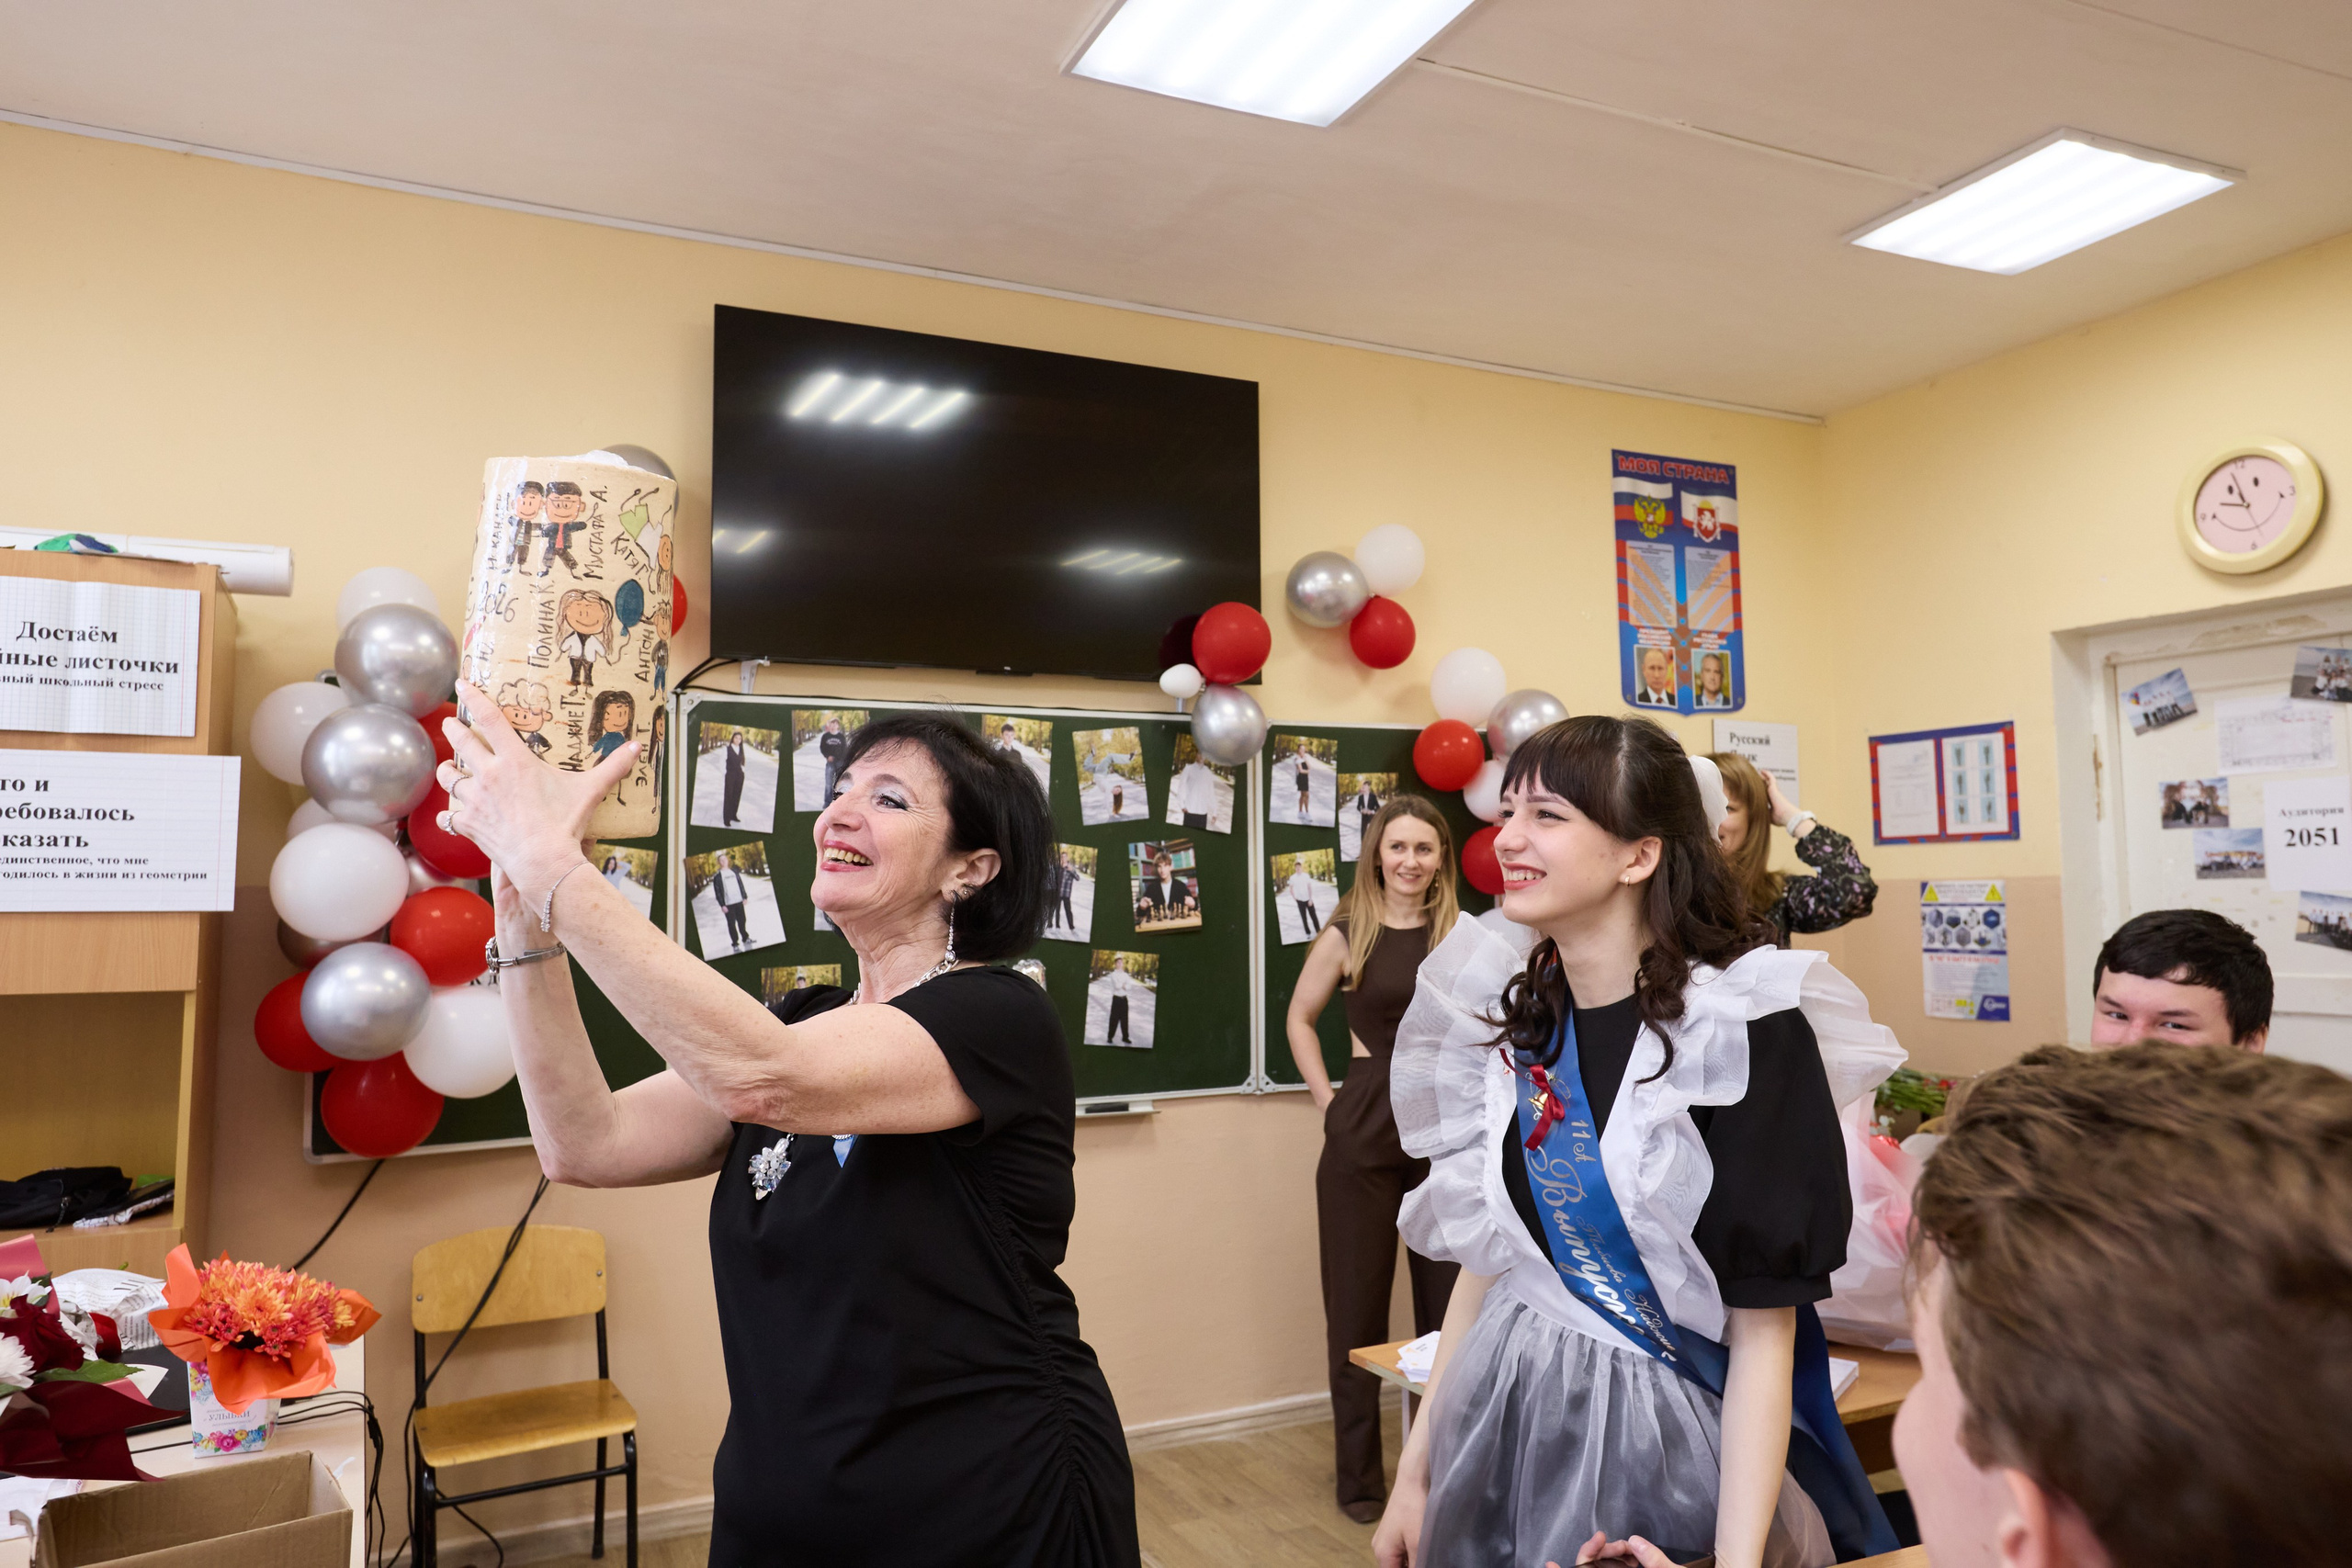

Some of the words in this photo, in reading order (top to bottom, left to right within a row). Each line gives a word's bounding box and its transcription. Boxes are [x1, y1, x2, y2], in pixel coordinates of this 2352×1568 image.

[1618, 456, 1661, 475] МОЯ
[1663, 462, 1729, 484] СТРАНА
[2289, 485, 2296, 497] 3
[582, 513, 605, 581] МУСТАФА
[477, 581, 519, 623] 2026
[17, 621, 118, 643] Достаём
[527, 599, 555, 669] ПОЛИНА
[634, 627, 656, 682] АНТОН
[64, 657, 179, 673] листочки
[0, 673, 34, 684] ный
[40, 677, 114, 687] школьный
[119, 682, 164, 691] стресс
[558, 709, 585, 772] НАДЖИЕ
[1729, 732, 1771, 746] Русский
[0, 778, 26, 792] то
[35, 780, 50, 792] и
[2278, 807, 2344, 818] Аудитория
[2, 834, 89, 848] казать
[2284, 827, 2339, 847] 2051
[1, 872, 58, 880] одилось
[140, 872, 208, 882] геометрии
